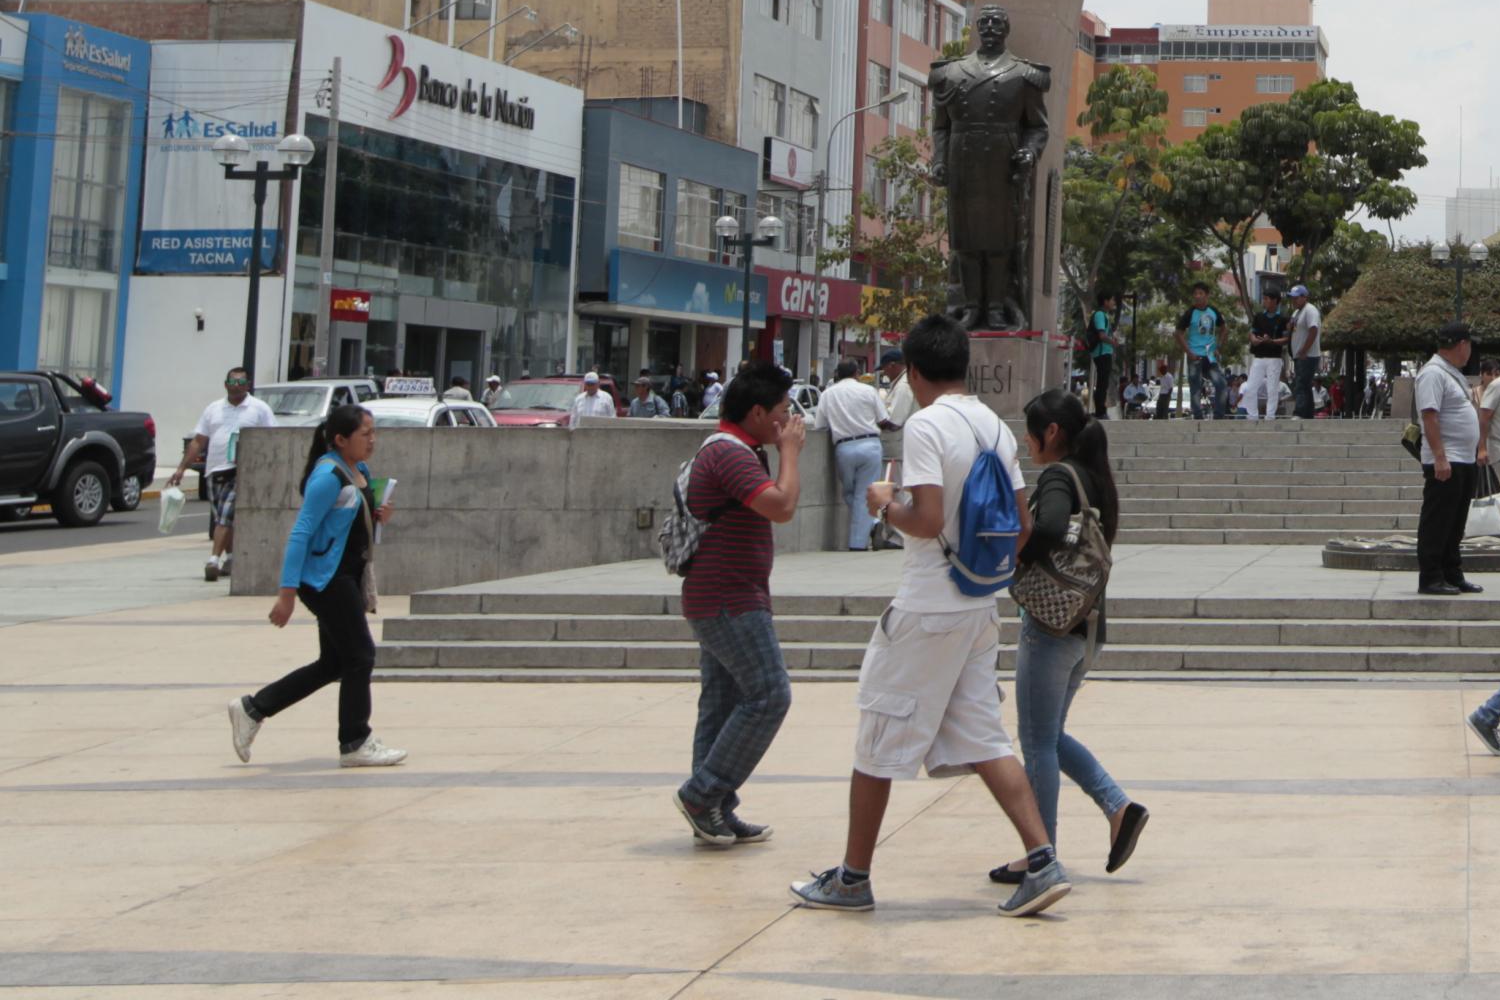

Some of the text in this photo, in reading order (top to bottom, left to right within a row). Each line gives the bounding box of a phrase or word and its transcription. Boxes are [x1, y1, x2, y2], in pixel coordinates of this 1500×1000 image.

[1195, 25, 1314, 38] Emperador
[89, 43, 131, 72] EsSalud
[418, 64, 536, 130] Banco de la Nación
[203, 121, 277, 138] EsSalud
[152, 236, 271, 249] RED ASISTENCIL
[189, 252, 235, 264] TACNA
[781, 276, 829, 315] carsa
